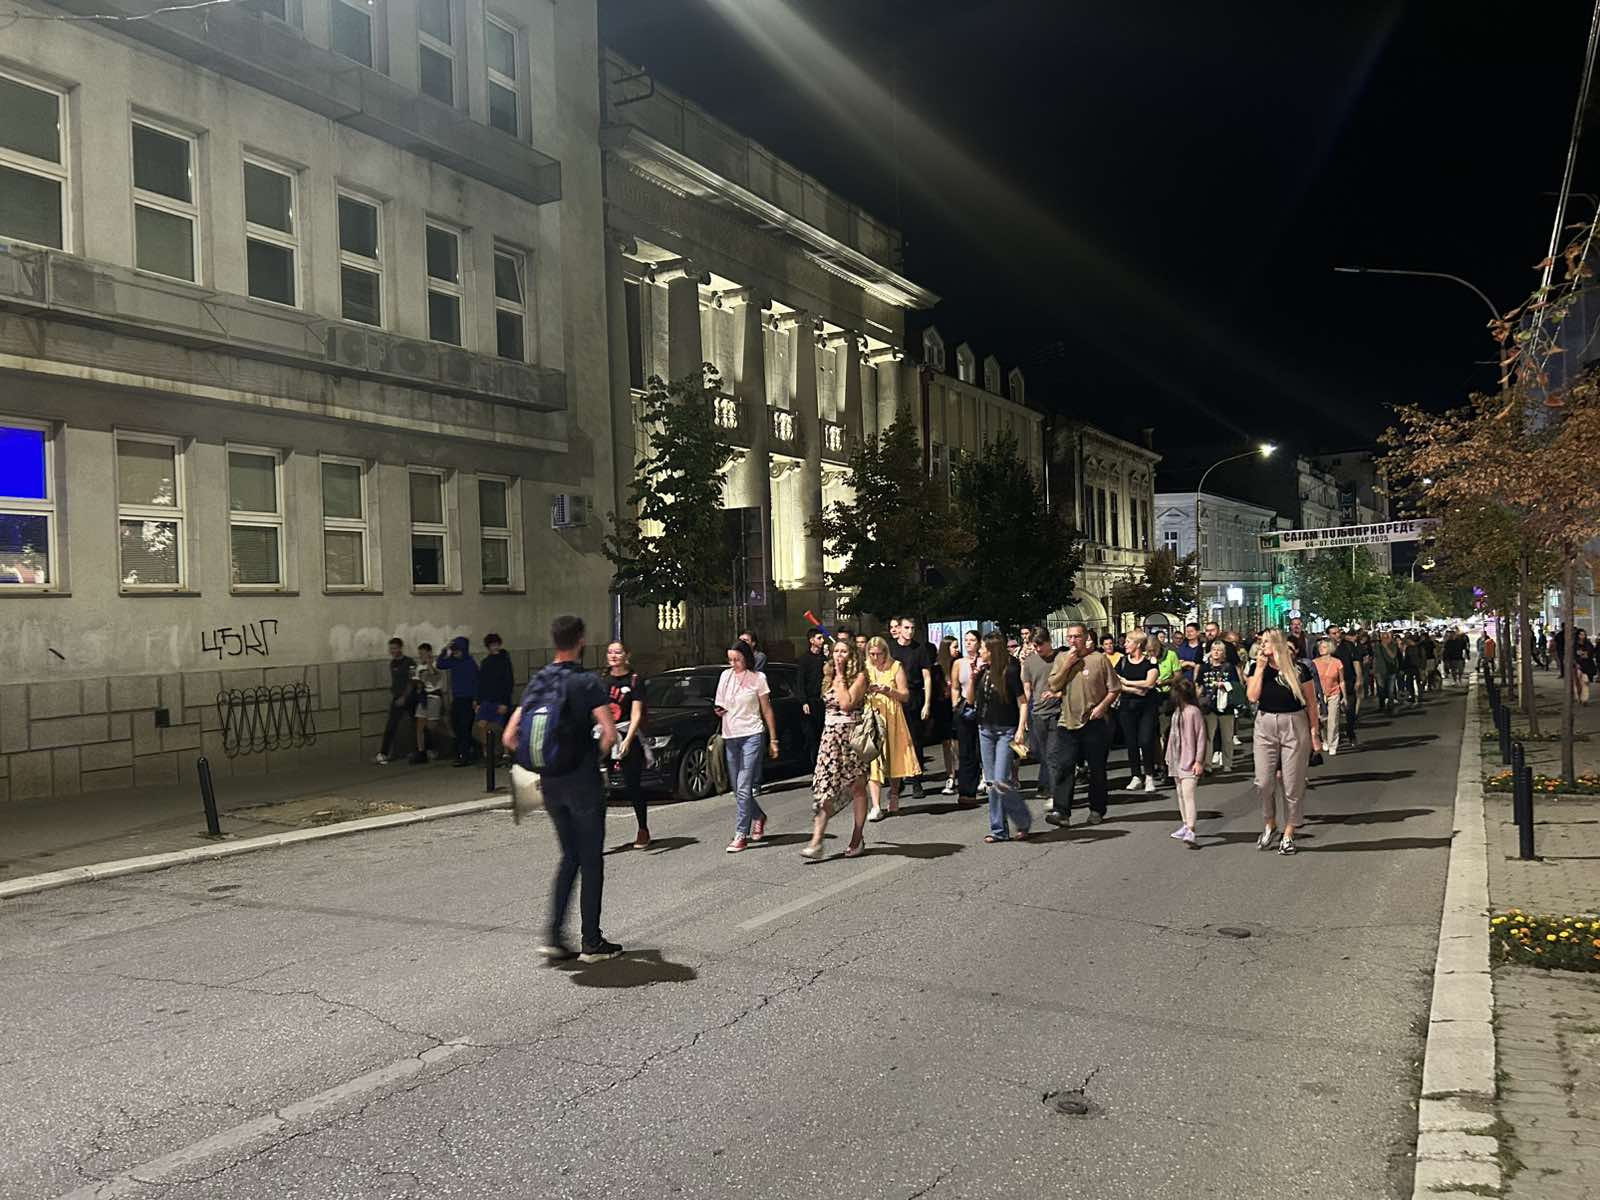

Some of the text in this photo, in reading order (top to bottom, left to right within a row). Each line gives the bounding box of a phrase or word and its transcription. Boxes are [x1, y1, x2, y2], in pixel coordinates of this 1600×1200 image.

[1284, 531, 1318, 542] САЈАМ
[1322, 522, 1415, 539] ПОЉОПРИВРЕДЕ
[1330, 536, 1369, 546] СЕПТЕМБАР
